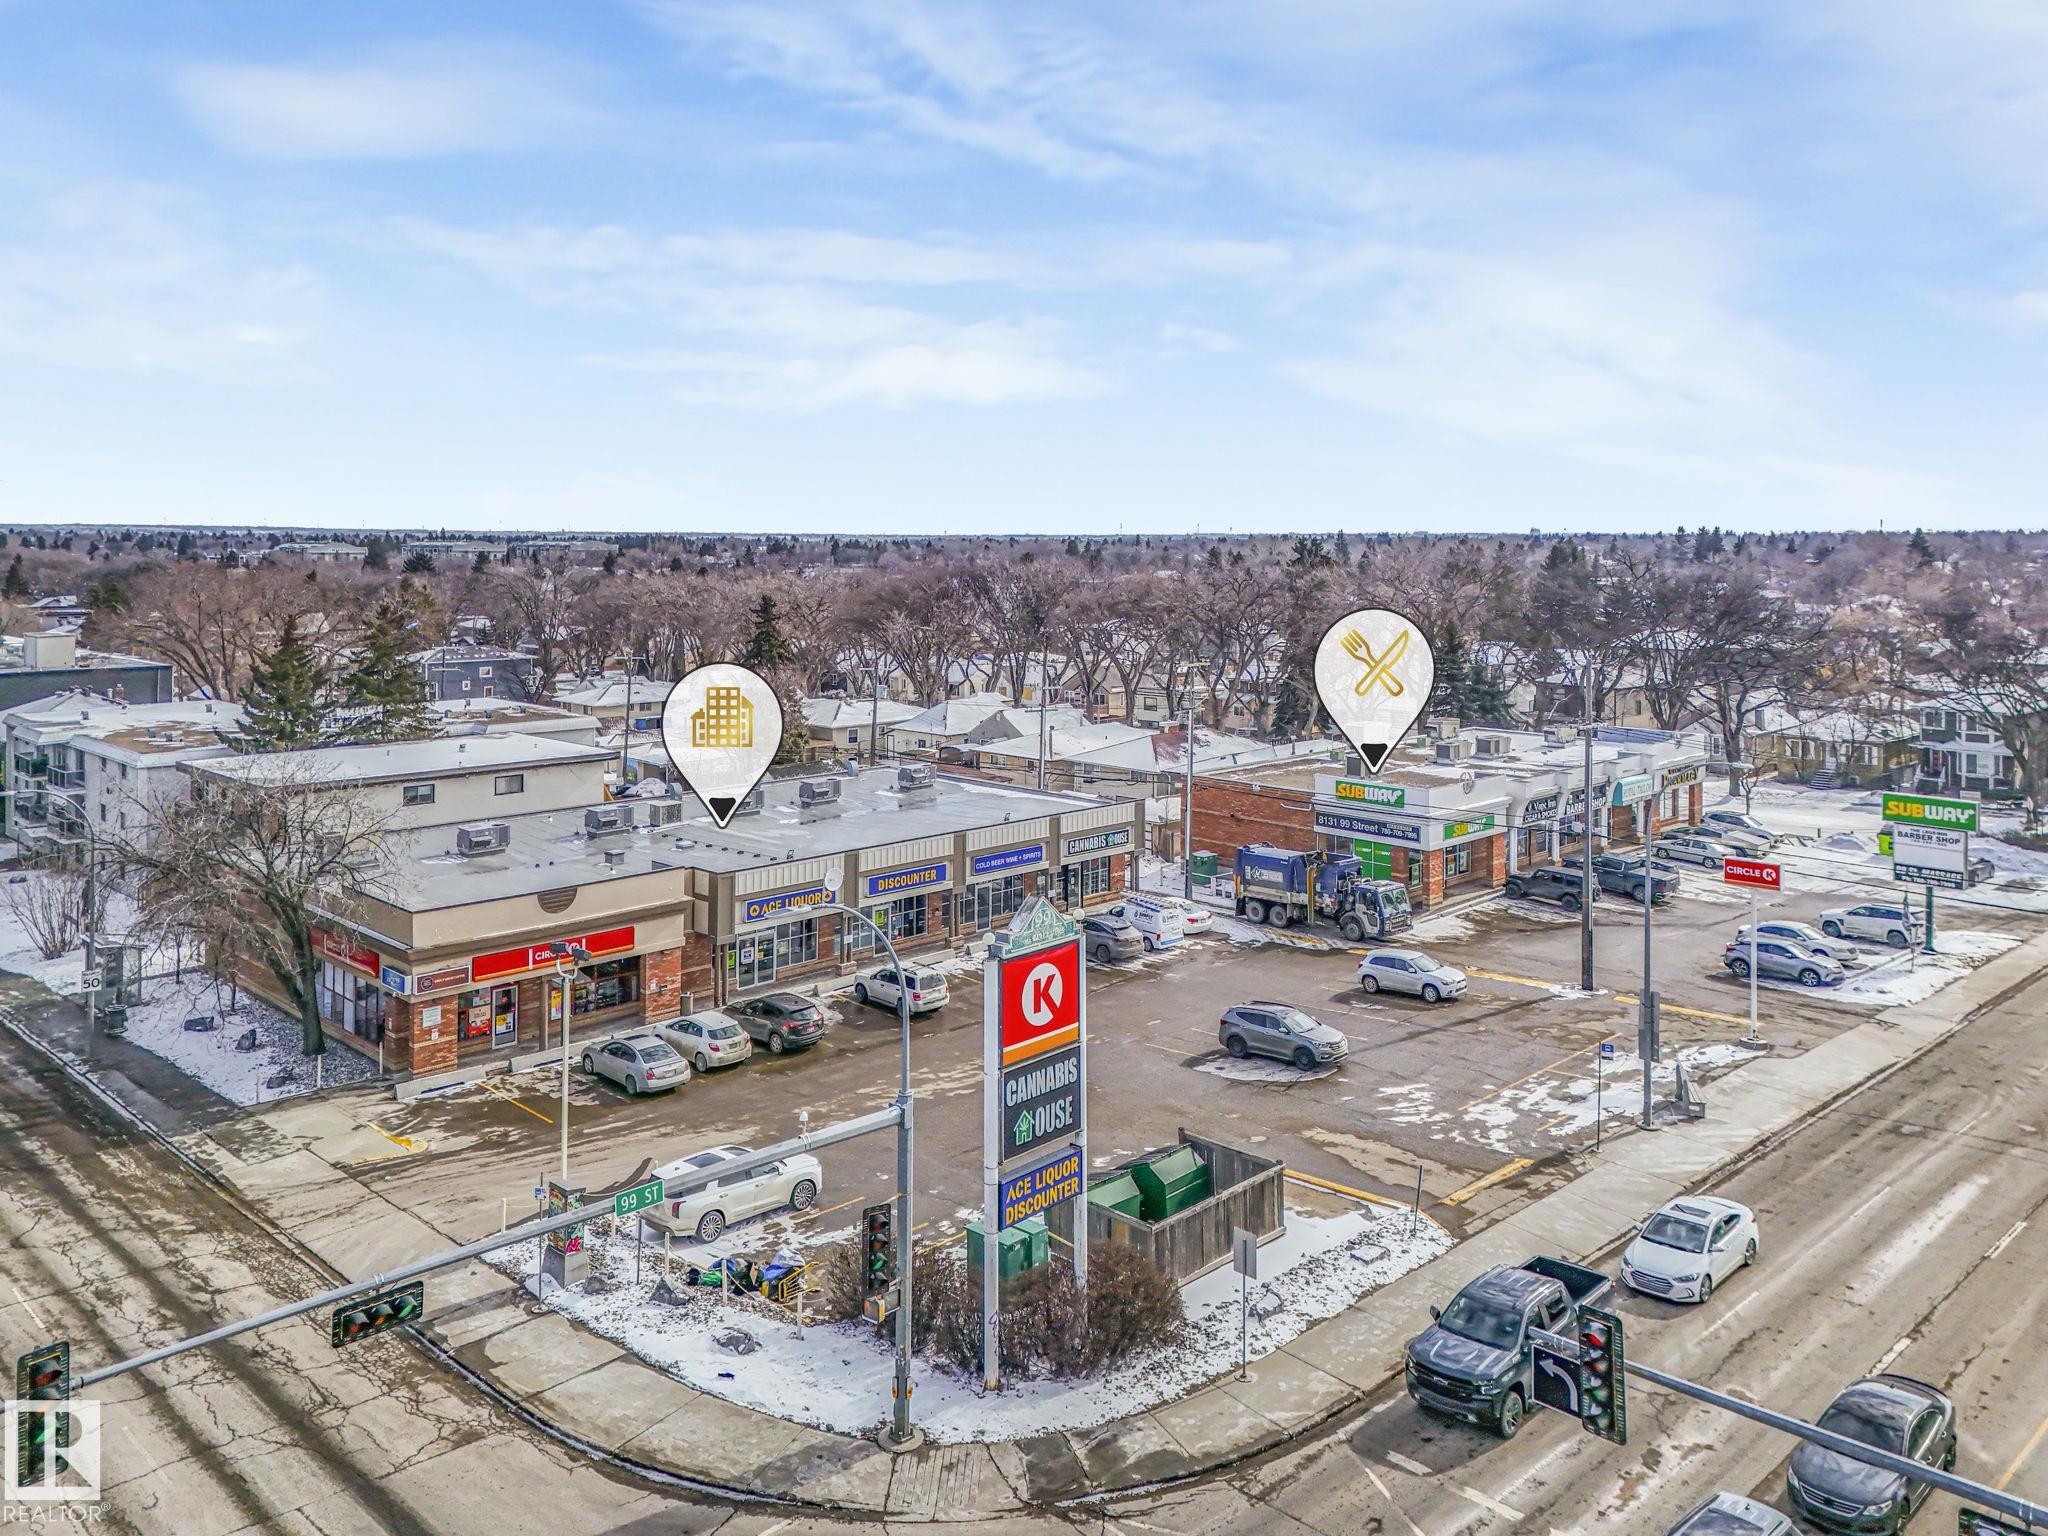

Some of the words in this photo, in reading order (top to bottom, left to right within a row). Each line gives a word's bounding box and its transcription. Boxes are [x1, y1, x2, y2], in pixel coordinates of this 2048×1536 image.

[1337, 783, 1403, 805] SUBWAY
[1566, 802, 1585, 814] BARBE
[1592, 797, 1607, 809] SHOP
[1885, 801, 1975, 823] SUBWAY
[1318, 815, 1337, 826] 8131
[1339, 818, 1350, 828] 99
[1352, 820, 1379, 833] Street
[1453, 818, 1487, 837] SUBWAY
[1069, 835, 1106, 854] CANNABIS
[1897, 830, 1933, 841] BARBER
[1936, 836, 1960, 845] SHOP
[975, 861, 991, 870] COLD
[991, 858, 1005, 866] BEER
[1005, 856, 1018, 864] WINE
[1022, 850, 1041, 861] SPIRITS
[877, 869, 937, 891] DISCOUNTER
[1726, 865, 1761, 878] CIRCLE
[1764, 868, 1776, 881] K
[761, 901, 782, 915] ACE
[785, 894, 821, 910] LIQUOR
[83, 977, 100, 989] 50
[1033, 973, 1060, 1014] K
[1006, 1056, 1078, 1107] CANNABIS
[1006, 1176, 1031, 1204] ACE
[1036, 1156, 1079, 1191] LIQUOR
[621, 1193, 637, 1211] 99
[645, 1186, 659, 1203] ST
[1005, 1176, 1079, 1225] DISCOUNTER
